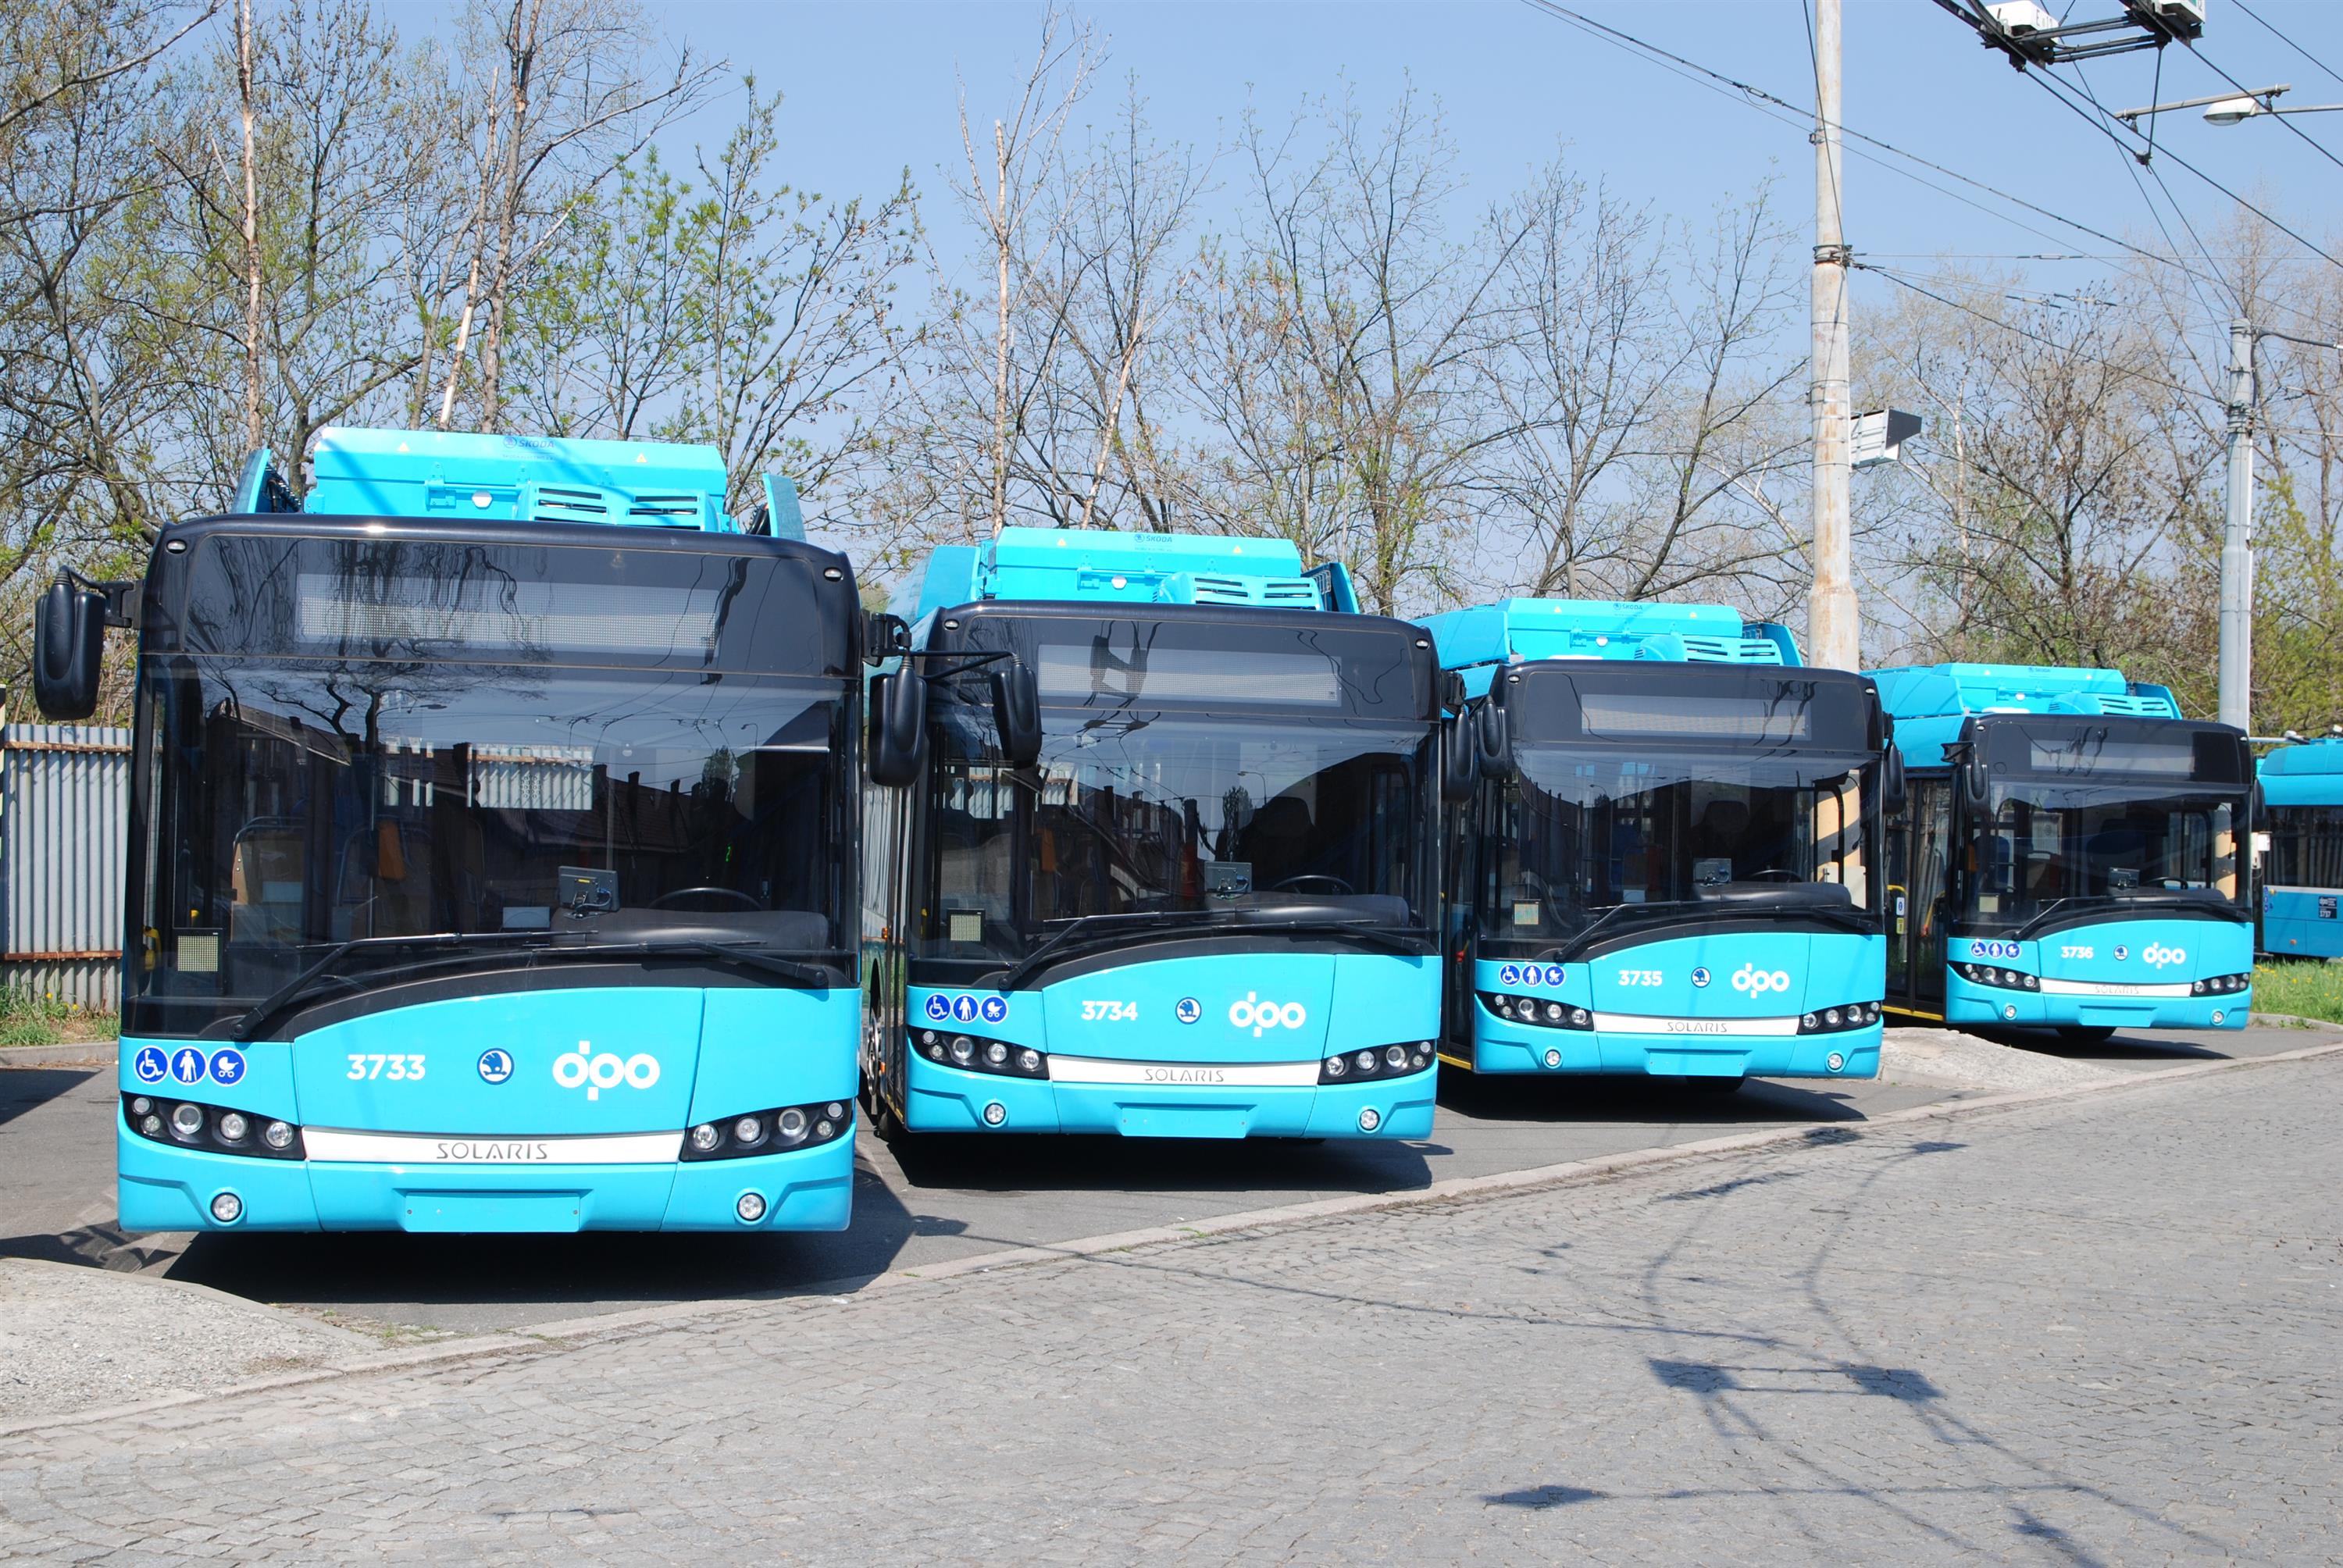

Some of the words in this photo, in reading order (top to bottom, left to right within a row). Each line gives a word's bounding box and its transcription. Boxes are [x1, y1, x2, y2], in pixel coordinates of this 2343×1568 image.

[1146, 534, 1173, 543] ŠKODA
[2061, 946, 2094, 958] 3736
[2142, 942, 2186, 969] dpo
[1618, 970, 1663, 987] 3735
[1731, 963, 1790, 999] dpo
[2095, 985, 2140, 994] SOLARIS
[1081, 1000, 1138, 1021] 3734
[1229, 991, 1307, 1037] dpo
[1667, 1021, 1728, 1032] SOLARIS
[346, 1054, 426, 1081] 3733
[552, 1040, 661, 1100] dpo
[1144, 1068, 1224, 1082] SOLARIS
[437, 1142, 548, 1160] SOLARIS
